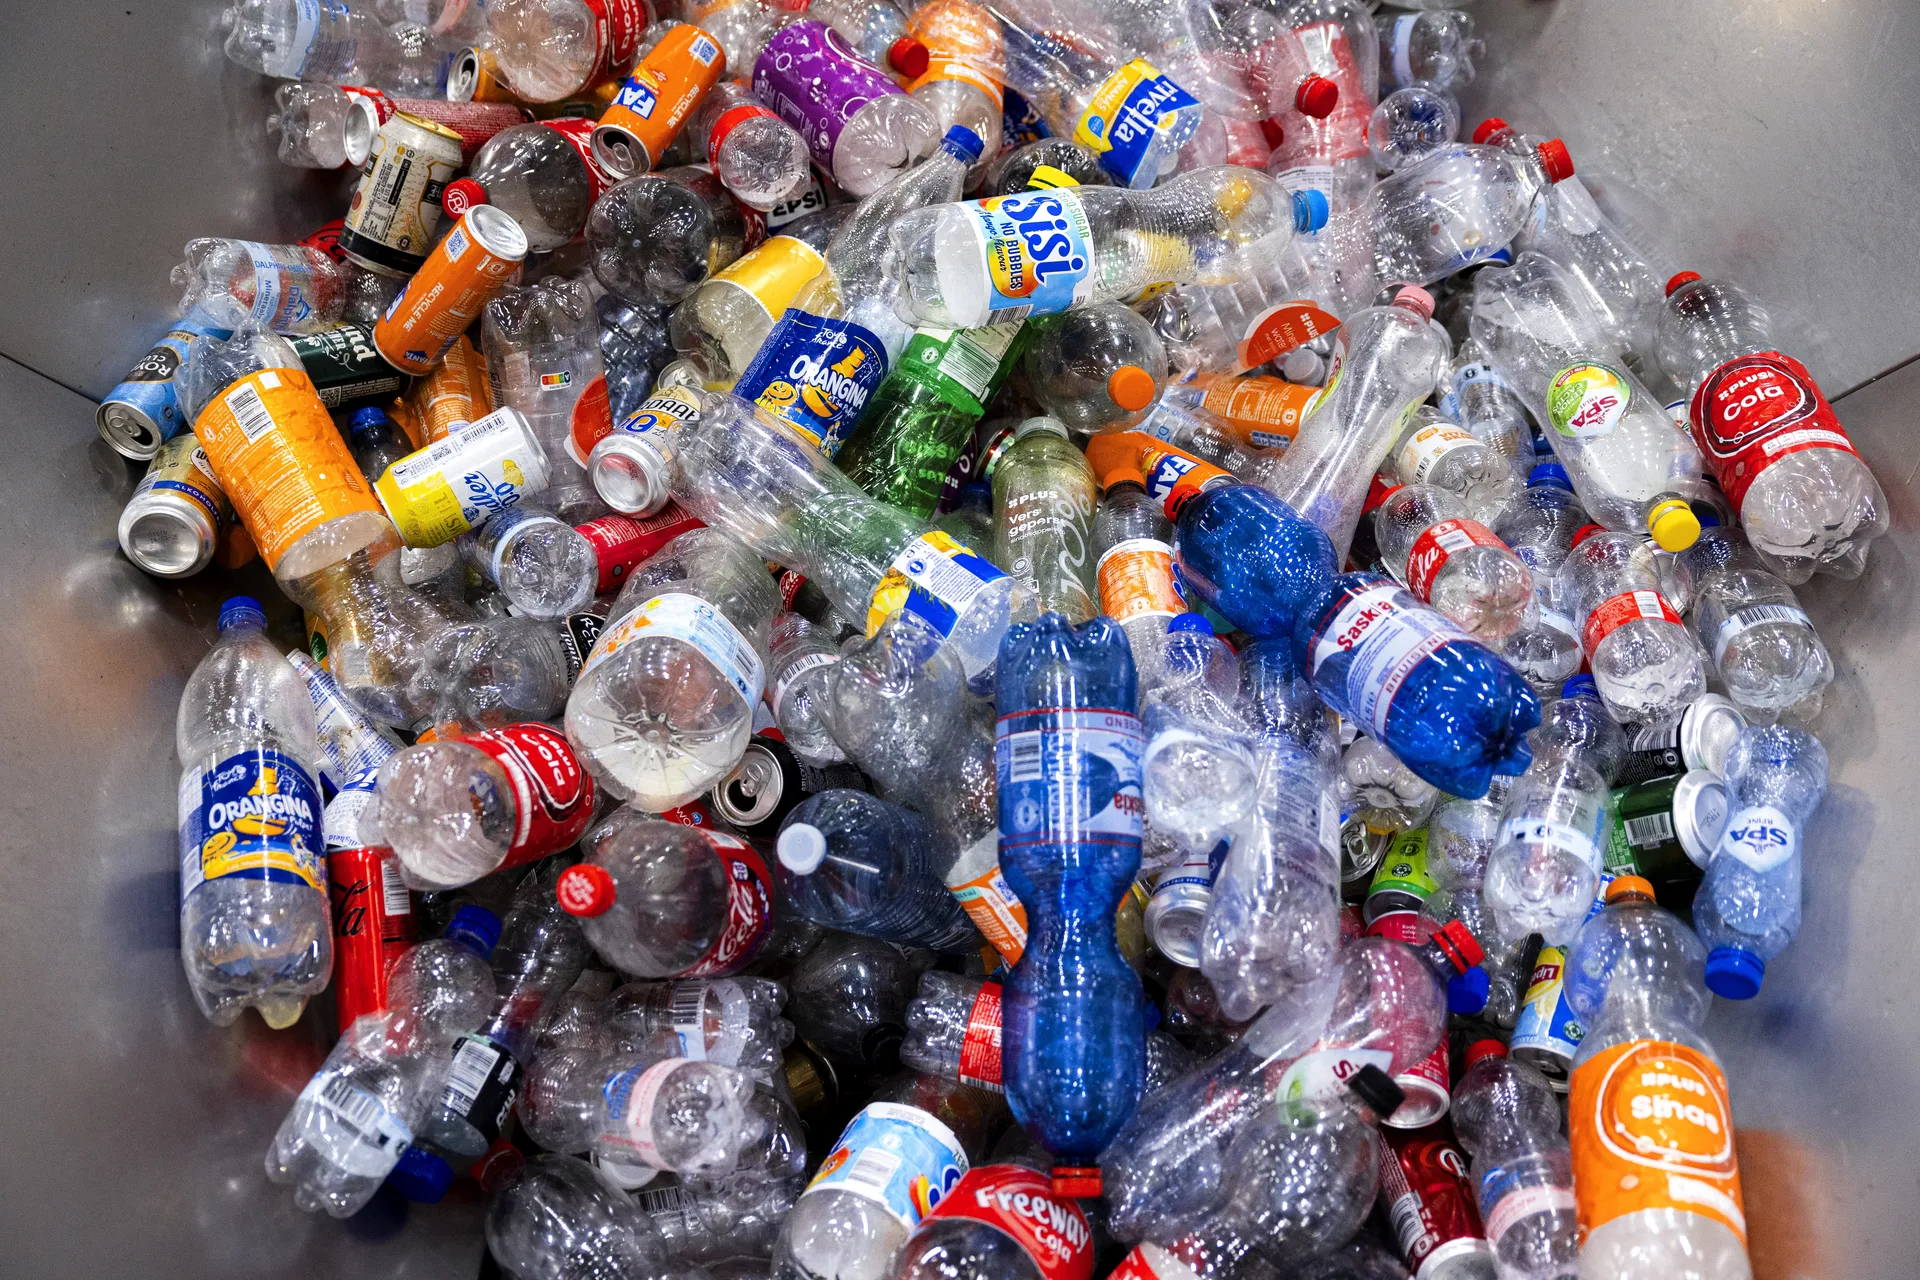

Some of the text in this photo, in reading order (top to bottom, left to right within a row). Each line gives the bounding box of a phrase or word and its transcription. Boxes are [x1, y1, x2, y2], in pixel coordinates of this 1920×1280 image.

[666, 84, 700, 129] RECYCLE ME
[1098, 77, 1128, 111] ANANAS
[1114, 80, 1179, 143] rivella
[773, 190, 823, 217] EPSI
[1071, 207, 1090, 239] SUGAR
[1000, 221, 1024, 291] NO BUBBLES
[414, 281, 445, 319] RECYCLE
[402, 316, 418, 333] ME
[1303, 319, 1320, 339] PLUS
[404, 350, 429, 365] FANTA
[789, 354, 869, 409] ORANGINA
[1556, 370, 1575, 386] CALORIE
[1728, 372, 1771, 395] PLUS
[1552, 382, 1583, 414] CACTUS
[1557, 388, 1584, 416] LEMON
[1571, 395, 1619, 428] SPA
[1579, 395, 1599, 410] FRUIT
[1723, 385, 1784, 421] Cola
[464, 470, 505, 516] adler
[1150, 455, 1200, 506] FAN
[1019, 490, 1060, 510] PLUS
[1337, 600, 1394, 651] Saskia
[559, 632, 580, 669] Tonic
[1386, 636, 1440, 694] BRUISEN
[1104, 715, 1139, 732] SEND
[520, 732, 566, 787] Cola
[209, 793, 314, 830] ORANGINA
[1730, 825, 1788, 846] SPA
[1656, 1072, 1707, 1098] PLUS
[1630, 1094, 1720, 1136] Sinas
[975, 1184, 1089, 1254] Freeway
[1034, 1225, 1072, 1263] Cola
